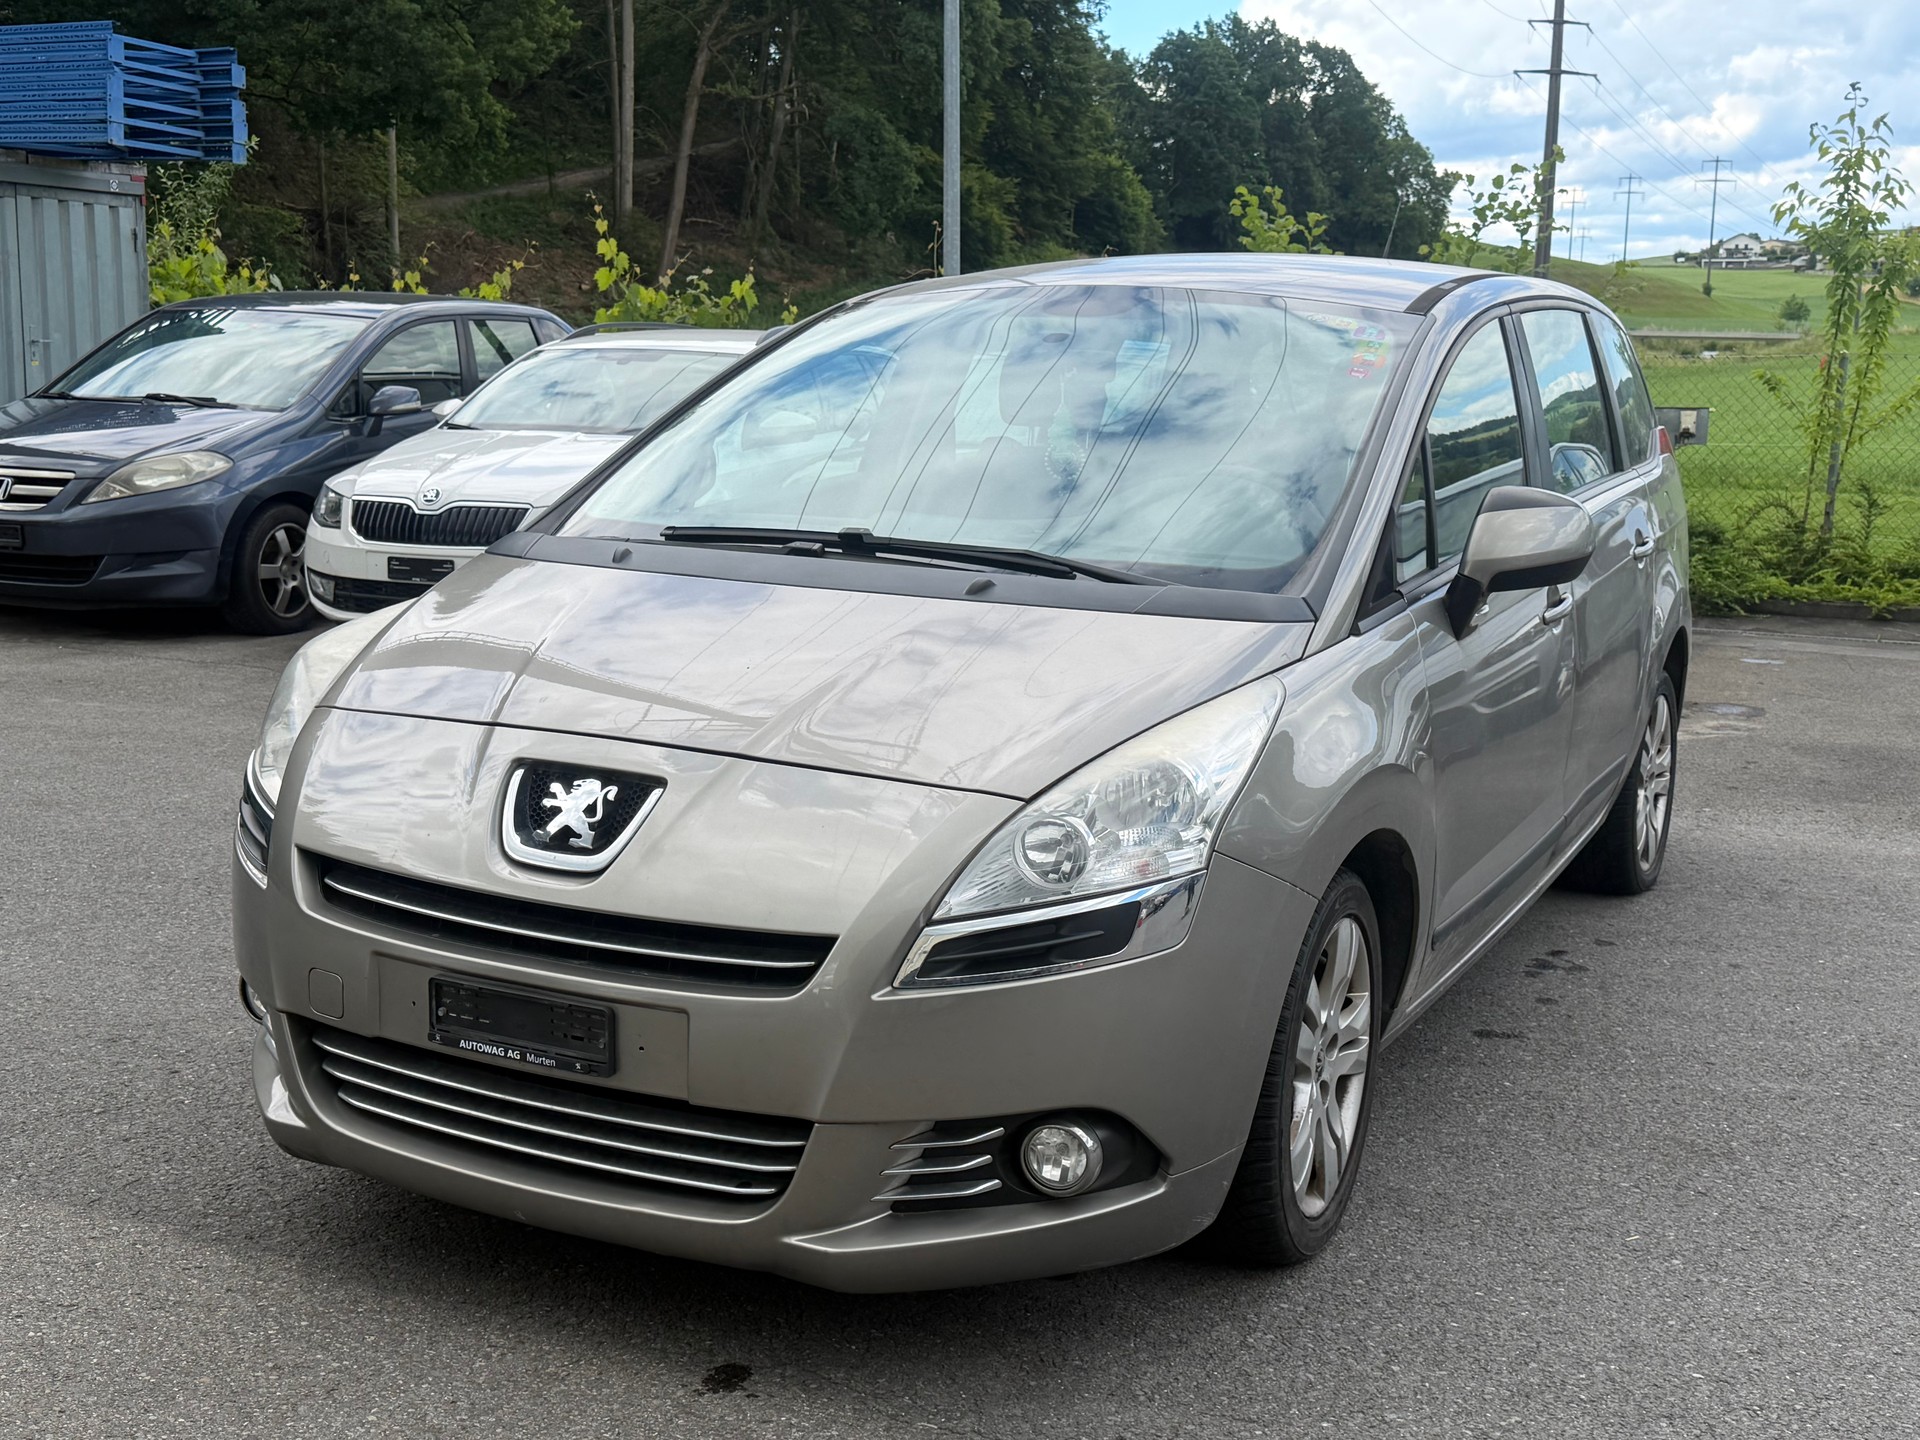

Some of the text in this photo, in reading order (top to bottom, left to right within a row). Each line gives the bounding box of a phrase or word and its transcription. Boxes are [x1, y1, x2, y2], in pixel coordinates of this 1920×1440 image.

[459, 1040, 556, 1067] AUTOWAG AG Murten
